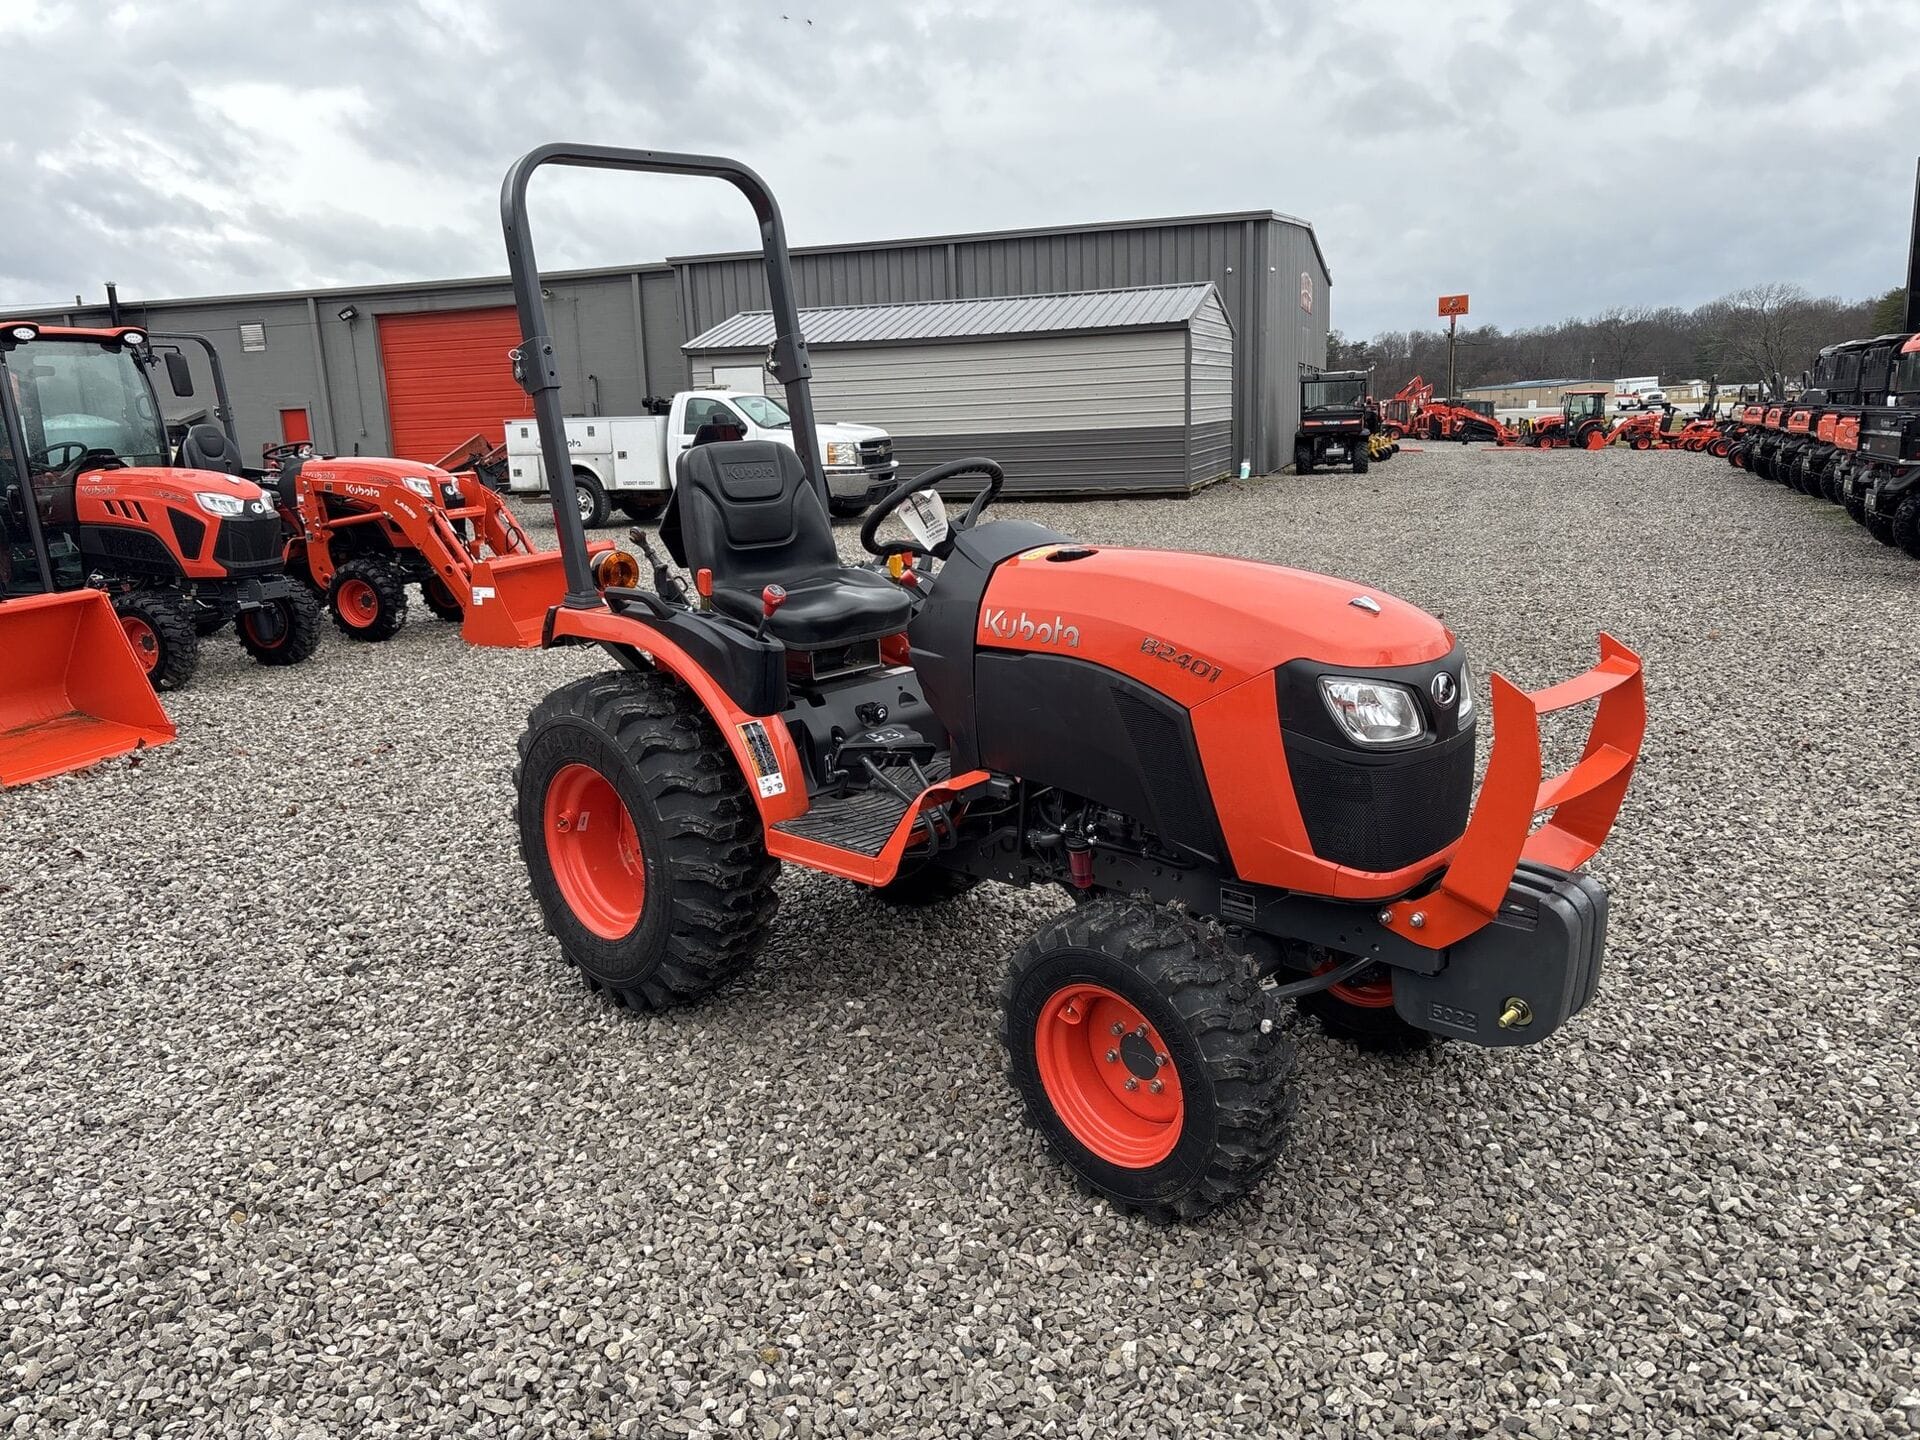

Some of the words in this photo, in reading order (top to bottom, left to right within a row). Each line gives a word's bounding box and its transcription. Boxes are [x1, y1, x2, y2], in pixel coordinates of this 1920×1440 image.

[1440, 306, 1466, 314] Kubota
[725, 464, 776, 480] Kubota
[81, 485, 116, 496] Kubota
[345, 483, 381, 498] Kubota
[984, 608, 1081, 649] Kubota
[1139, 636, 1223, 685] B2401
